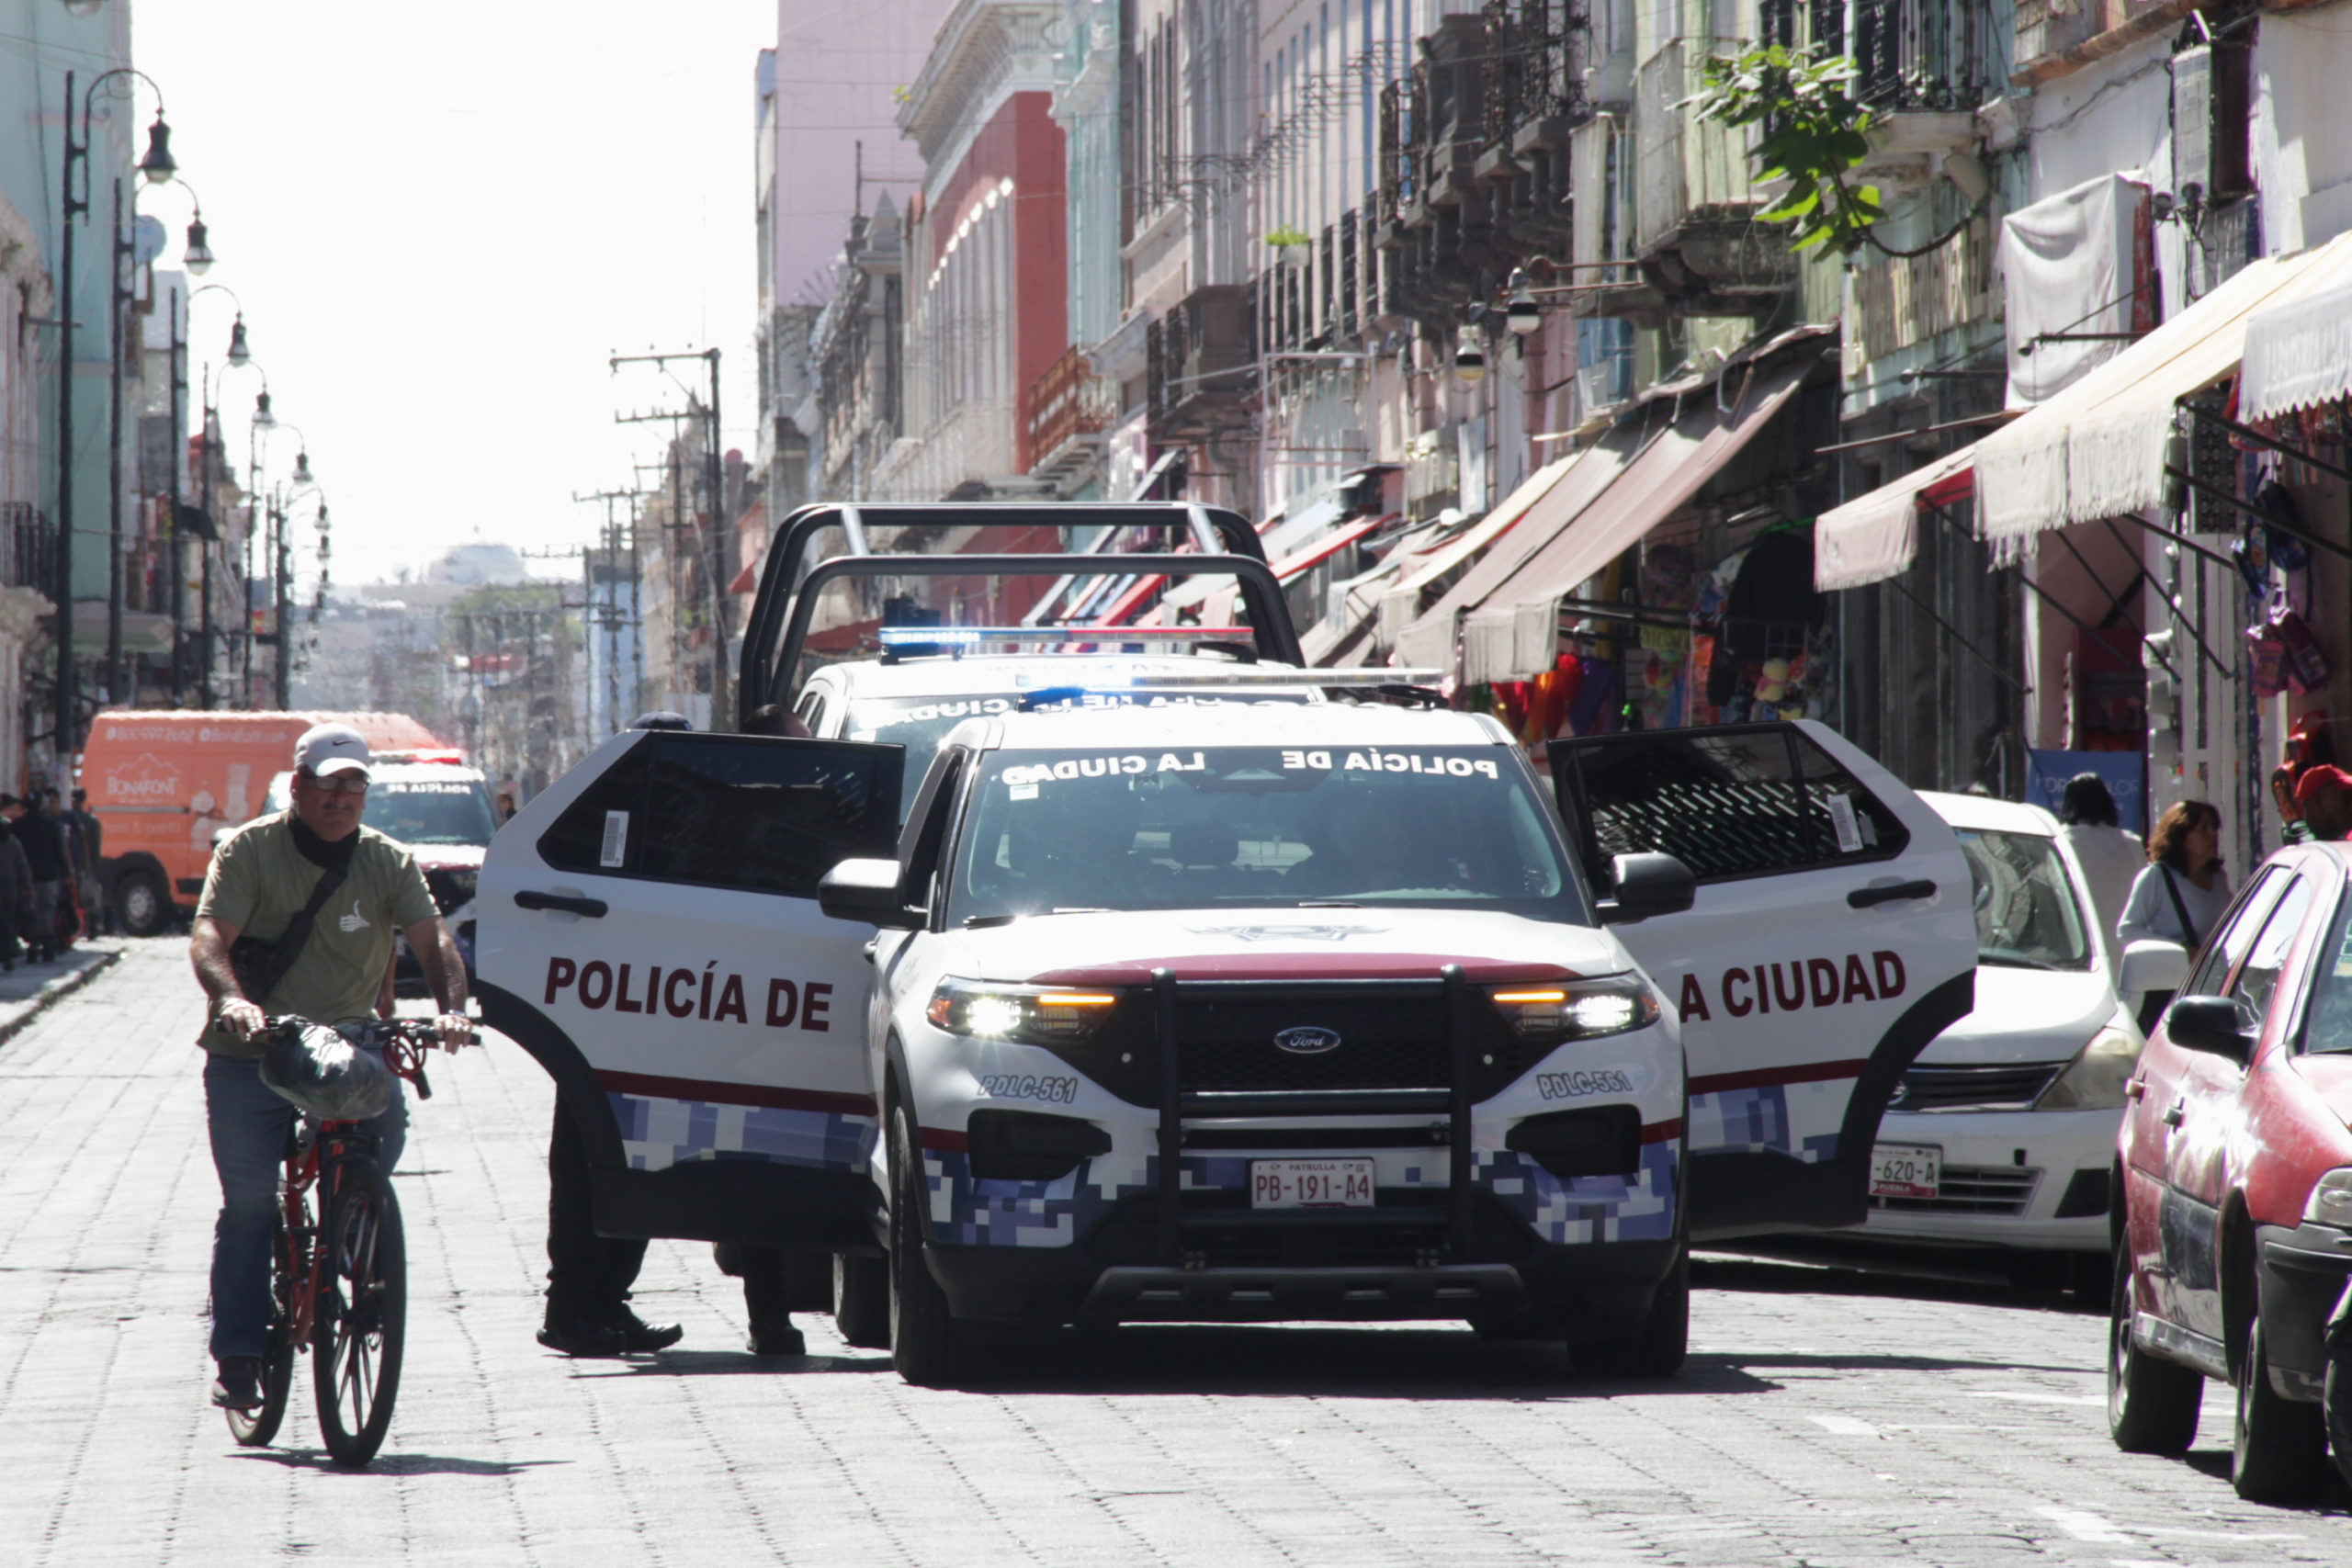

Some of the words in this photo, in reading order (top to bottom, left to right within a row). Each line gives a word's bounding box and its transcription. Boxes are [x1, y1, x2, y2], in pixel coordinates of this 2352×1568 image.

[107, 775, 179, 795] BONAFONT
[544, 956, 748, 1024] POLICÍA
[765, 977, 833, 1032] DE
[1679, 973, 1711, 1023] A
[1722, 950, 1906, 1018] CIUDAD
[1289, 1032, 1325, 1046] Ford
[978, 1075, 1078, 1103] PDLC-561
[1536, 1070, 1633, 1100] PDLC-561
[1289, 1163, 1336, 1171] PATRULLA
[1875, 1160, 1935, 1184] -620-A
[1256, 1174, 1370, 1201] PB-191-A4
